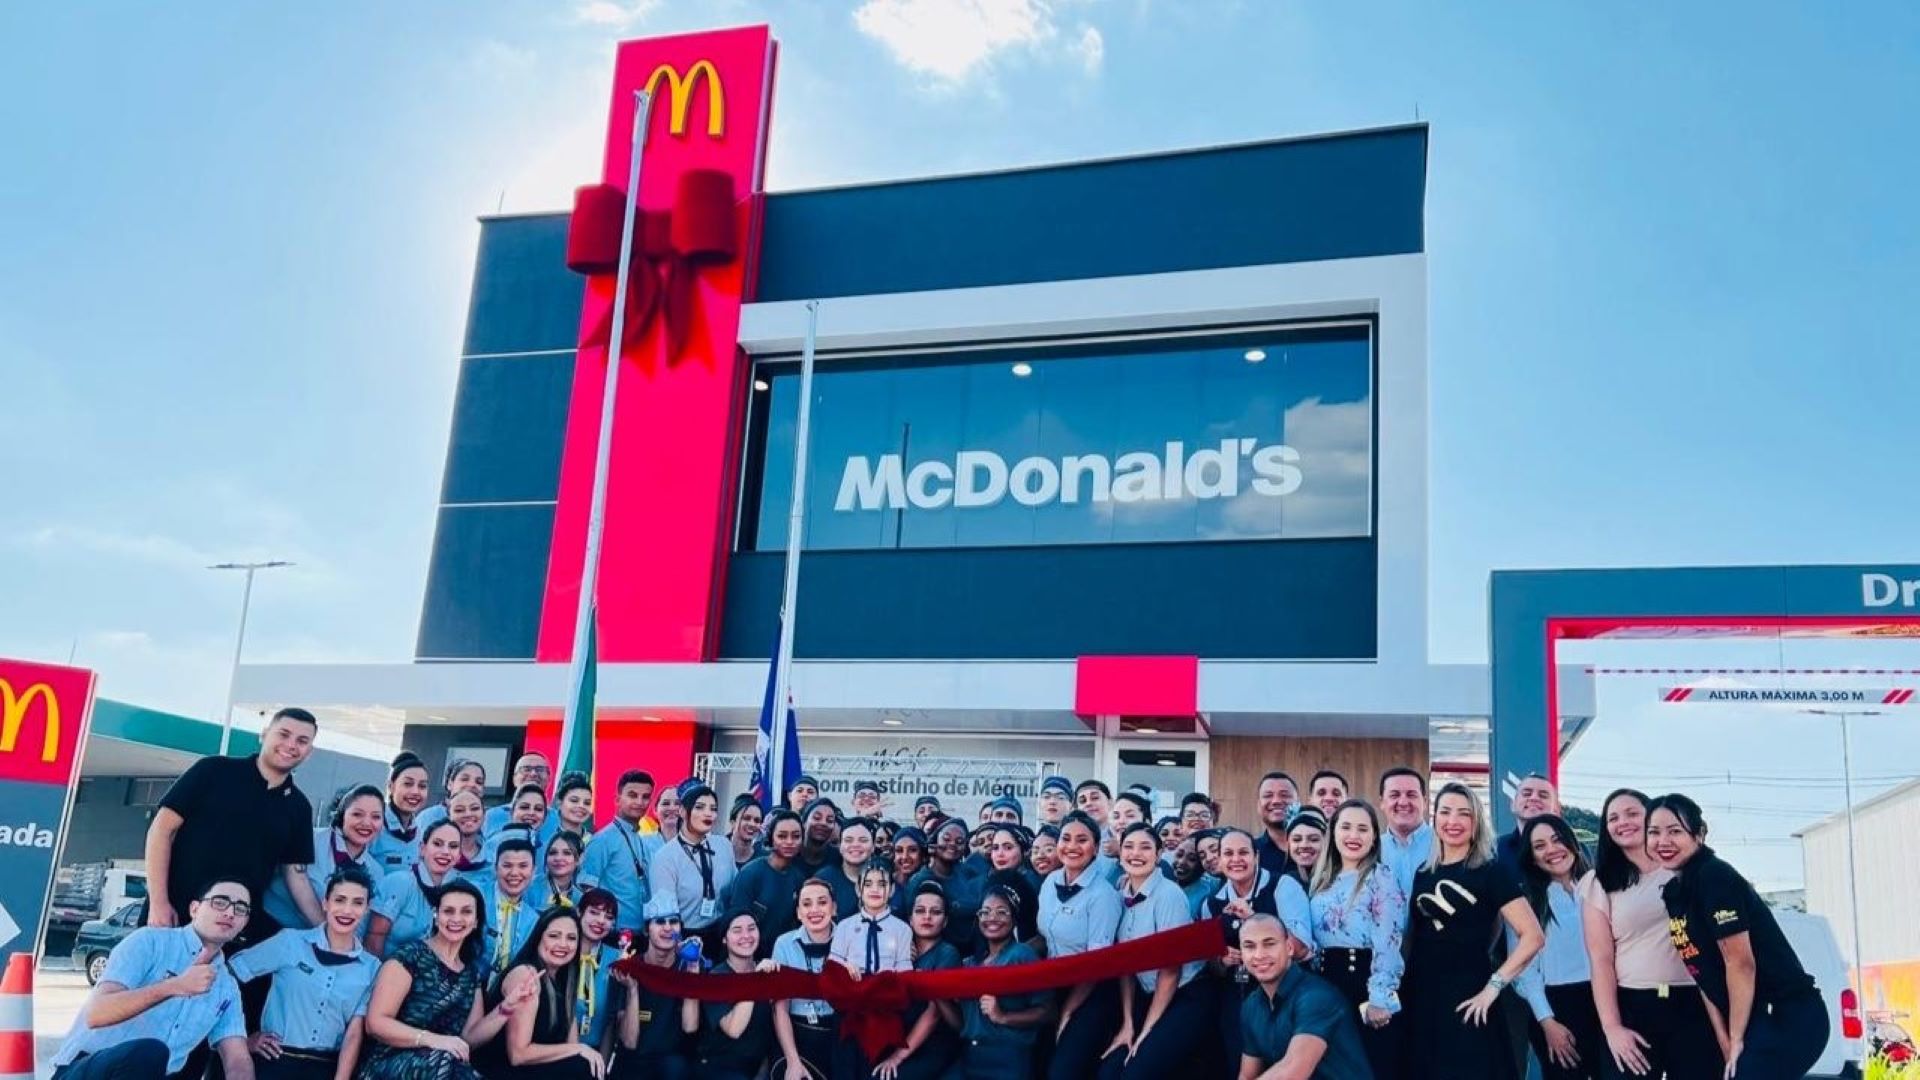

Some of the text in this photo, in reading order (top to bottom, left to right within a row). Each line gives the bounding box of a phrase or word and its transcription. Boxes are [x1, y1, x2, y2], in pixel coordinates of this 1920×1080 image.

[834, 437, 1302, 512] McDonald's
[1862, 573, 1920, 607] Dr
[1709, 690, 1758, 700] ALTURA
[1820, 690, 1849, 702] 3,00
[1851, 690, 1865, 701] M
[944, 779, 968, 796] de
[0, 822, 53, 848] ada
